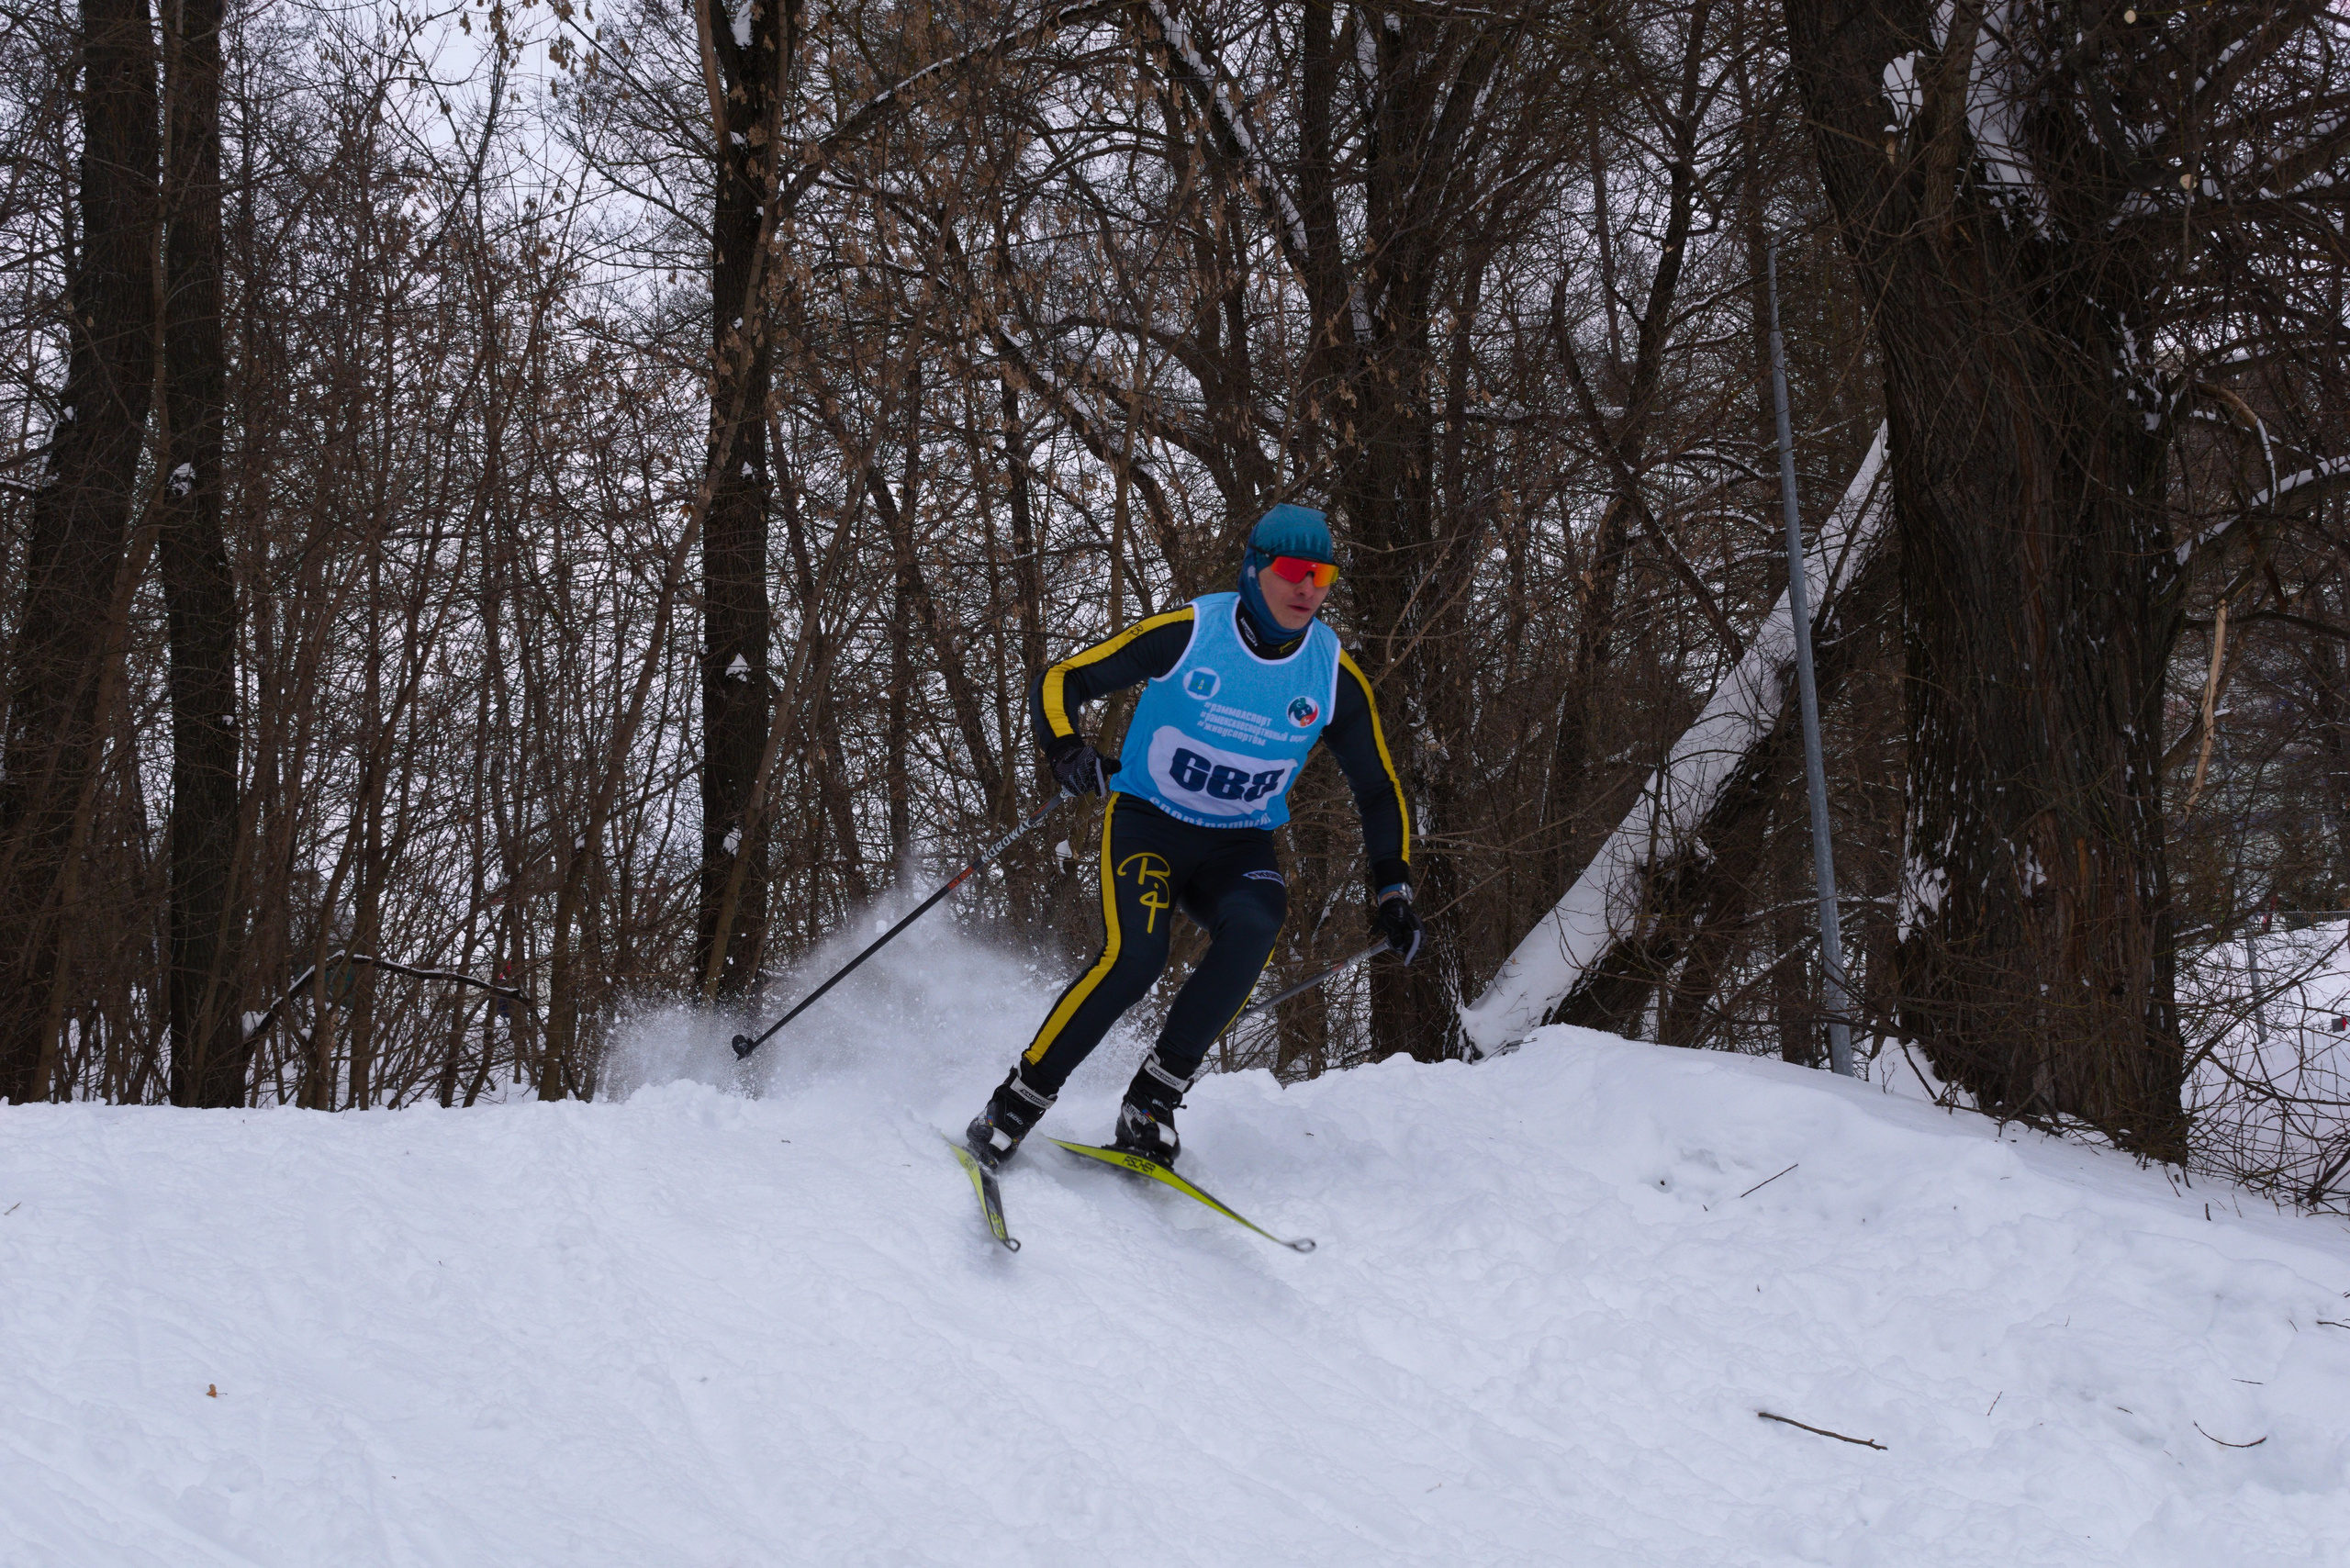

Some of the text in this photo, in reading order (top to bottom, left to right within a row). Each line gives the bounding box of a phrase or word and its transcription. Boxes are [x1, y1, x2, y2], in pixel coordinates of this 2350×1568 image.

[1169, 747, 1285, 802] 688
[980, 820, 1032, 863] NORDWAY
[1122, 1155, 1156, 1175] FISCHER
